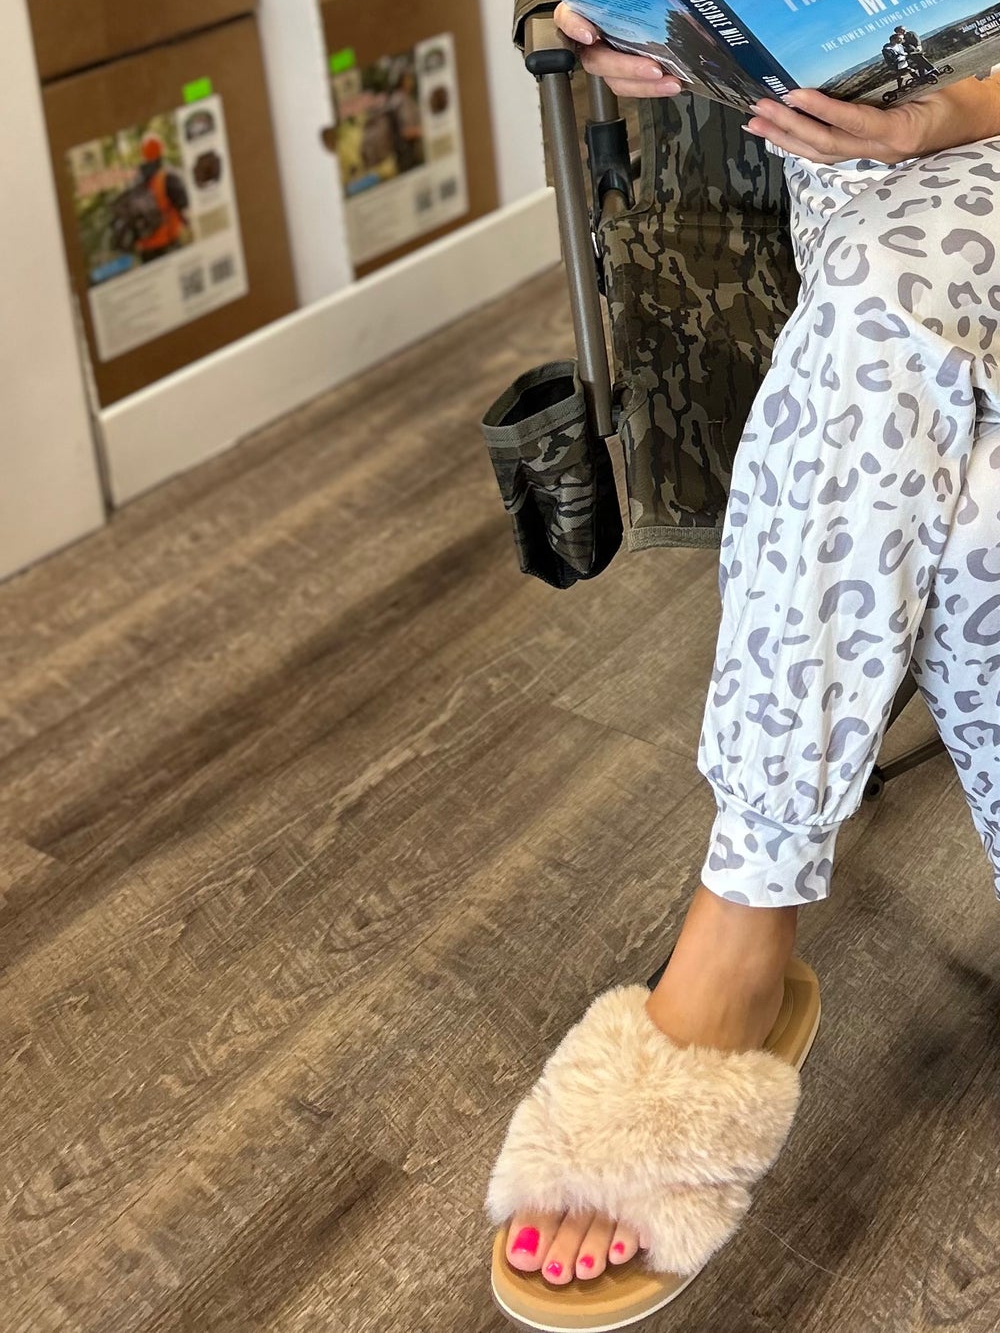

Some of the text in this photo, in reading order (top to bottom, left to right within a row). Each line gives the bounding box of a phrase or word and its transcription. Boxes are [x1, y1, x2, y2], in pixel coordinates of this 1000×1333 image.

[718, 27, 750, 47] MILE
[820, 40, 839, 53] THE
[837, 27, 867, 46] POWER
[875, 11, 903, 29] LIVING
[902, 5, 921, 18] LIFE
